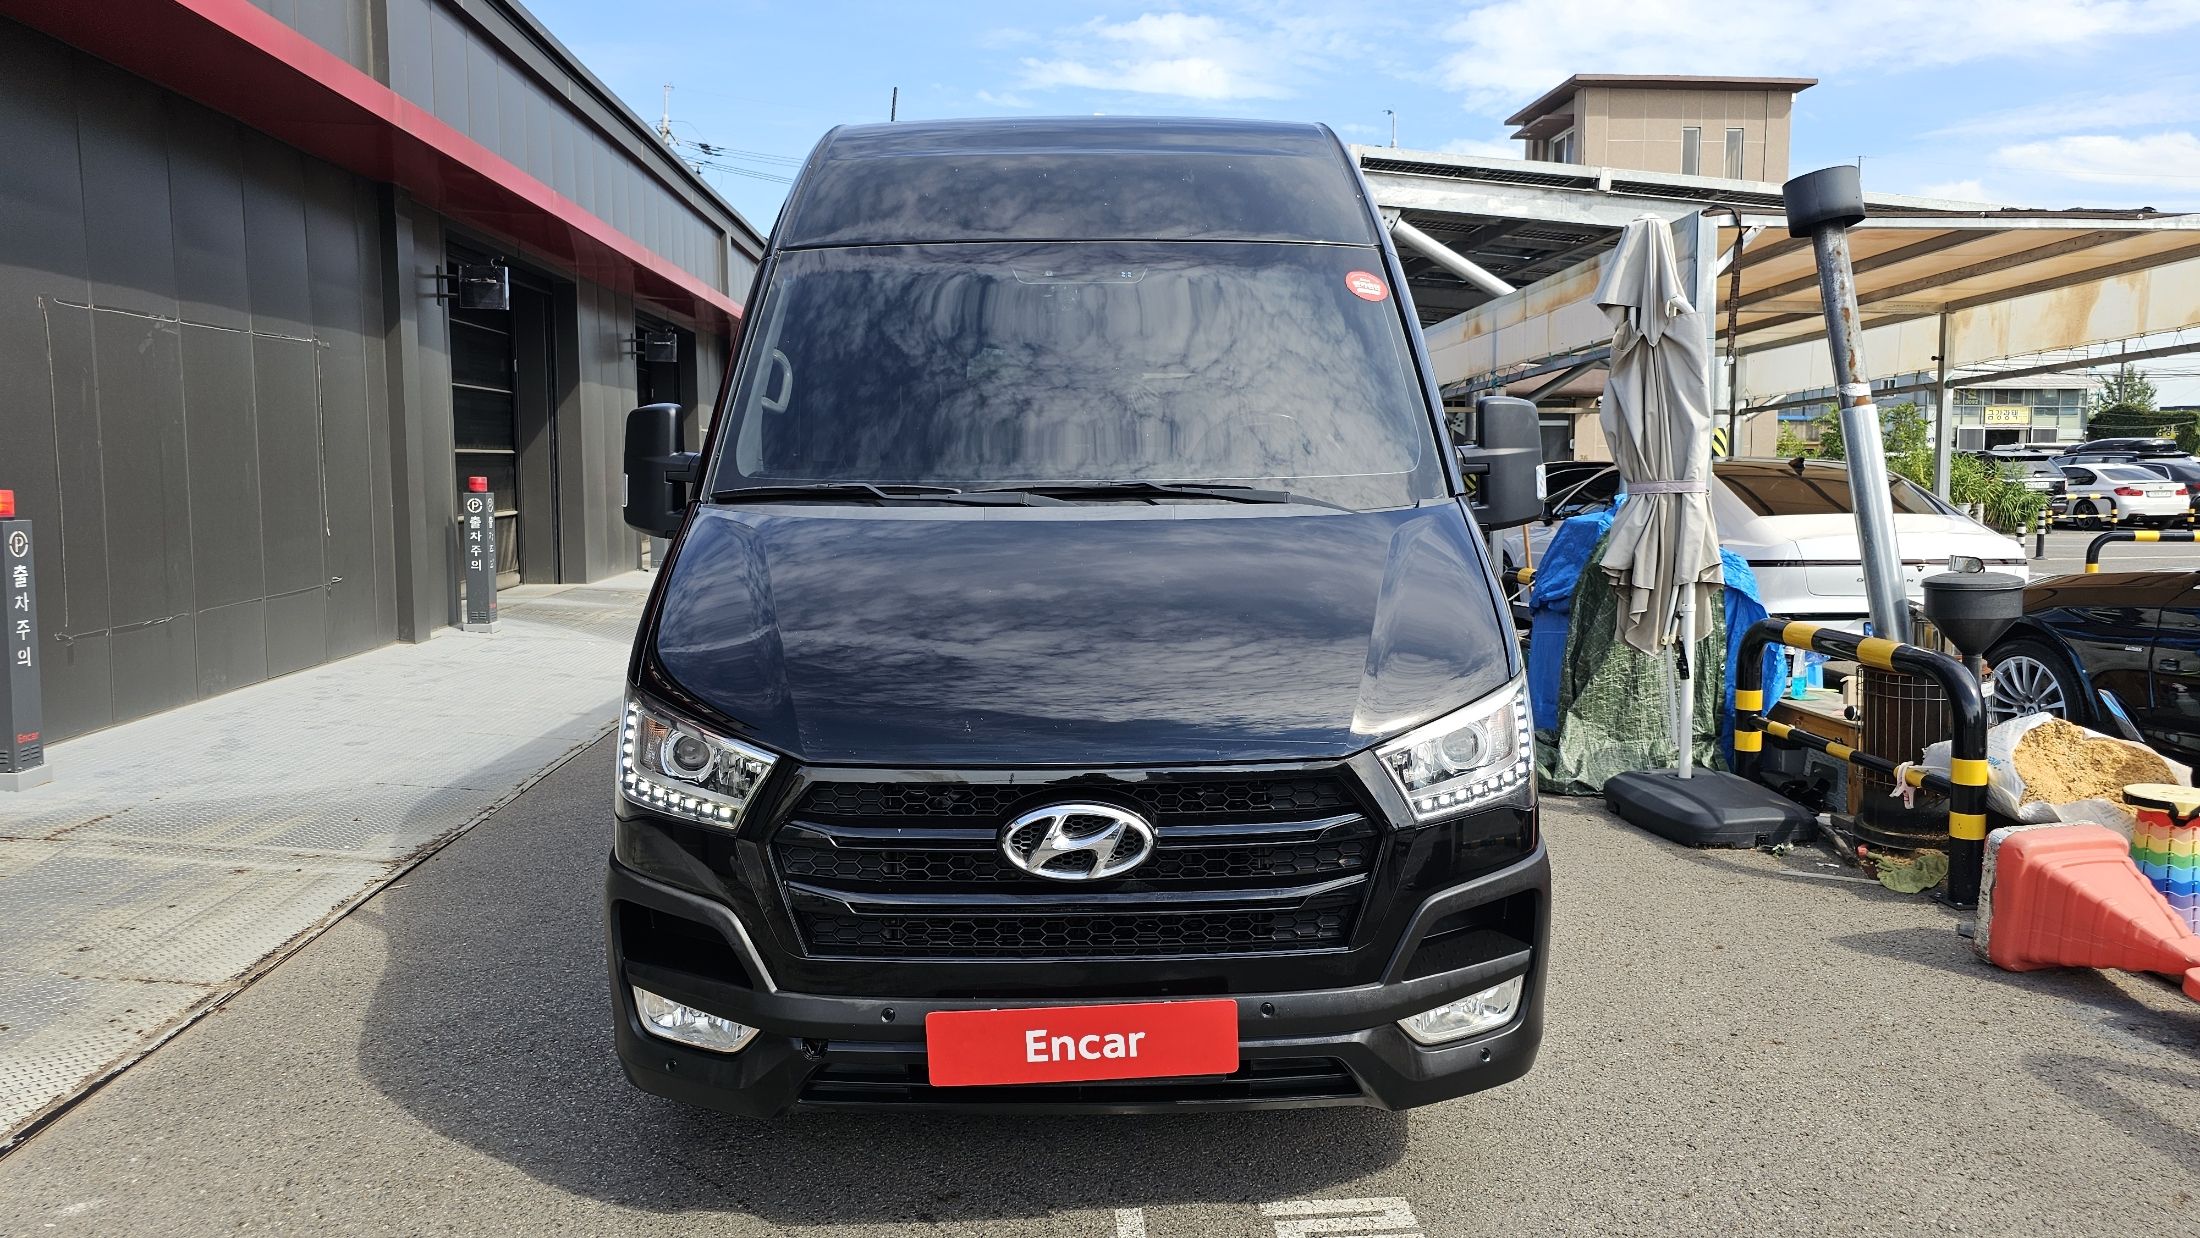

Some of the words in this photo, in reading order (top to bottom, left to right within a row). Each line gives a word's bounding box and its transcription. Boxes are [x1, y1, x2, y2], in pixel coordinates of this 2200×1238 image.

[1987, 409, 2019, 420] 금강광택
[469, 516, 483, 571] 출차주의
[13, 565, 32, 667] 출차주의
[1025, 1029, 1146, 1063] Encar
